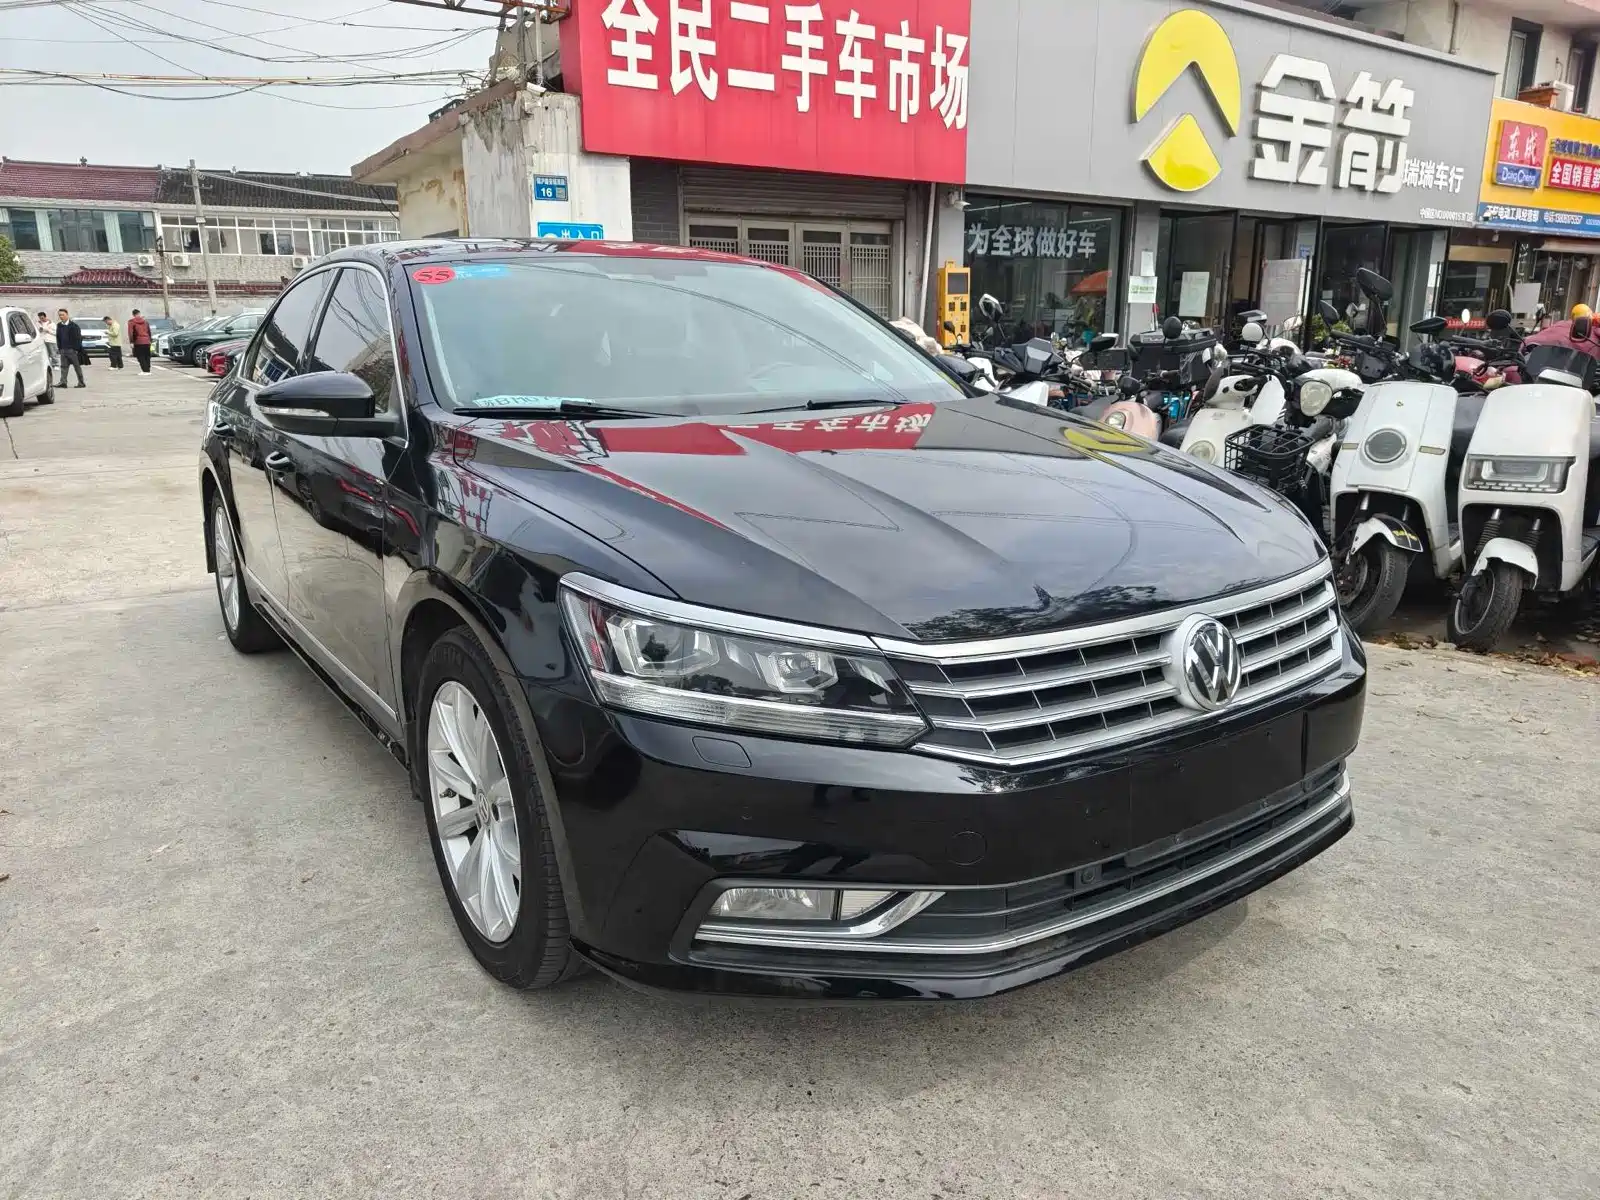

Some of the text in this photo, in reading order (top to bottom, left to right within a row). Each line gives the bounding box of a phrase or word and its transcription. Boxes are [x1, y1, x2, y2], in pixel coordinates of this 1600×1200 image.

[601, 0, 968, 129] 全民二手车市场
[540, 187, 553, 198] 16
[1402, 158, 1464, 193] 瑞瑞车行
[967, 223, 1097, 259] 为全球做好车
[418, 270, 450, 282] 55
